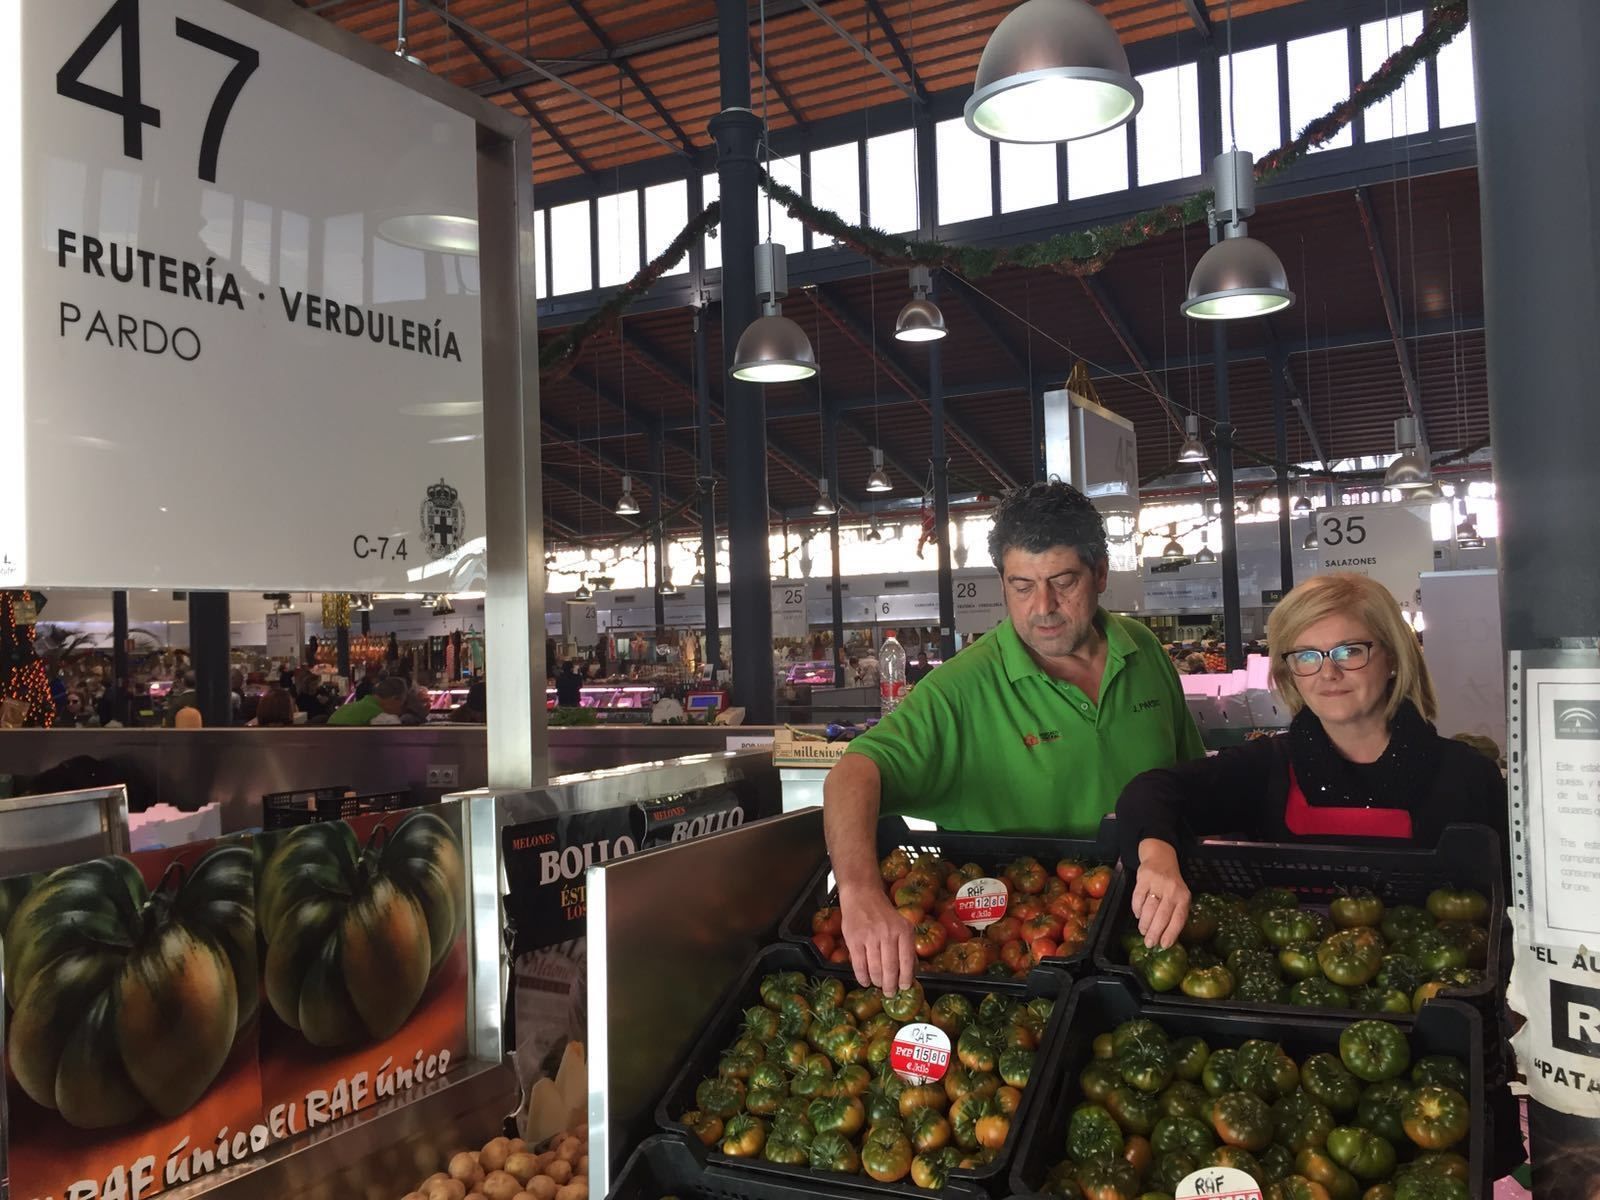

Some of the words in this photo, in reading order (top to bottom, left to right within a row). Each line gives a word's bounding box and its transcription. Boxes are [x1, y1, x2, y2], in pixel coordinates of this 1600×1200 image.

[56, 0, 260, 184] 47
[58, 228, 245, 311] FRUTERÍA
[279, 286, 462, 363] VERDULERÍA
[60, 301, 202, 362] PARDO
[1323, 516, 1367, 546] 35
[353, 534, 408, 561] C-7.4
[1325, 557, 1377, 568] SALAZONES
[784, 590, 803, 605] 25
[956, 582, 977, 598] 28
[585, 606, 596, 619] 23
[881, 602, 890, 615] 6
[616, 616, 624, 629] 5
[512, 832, 556, 851] MELONES
[967, 886, 985, 897] RAF
[305, 1070, 370, 1128] RAF
[375, 1049, 452, 1098] único
[165, 1124, 269, 1185] único
[1195, 1175, 1224, 1195] RAF
